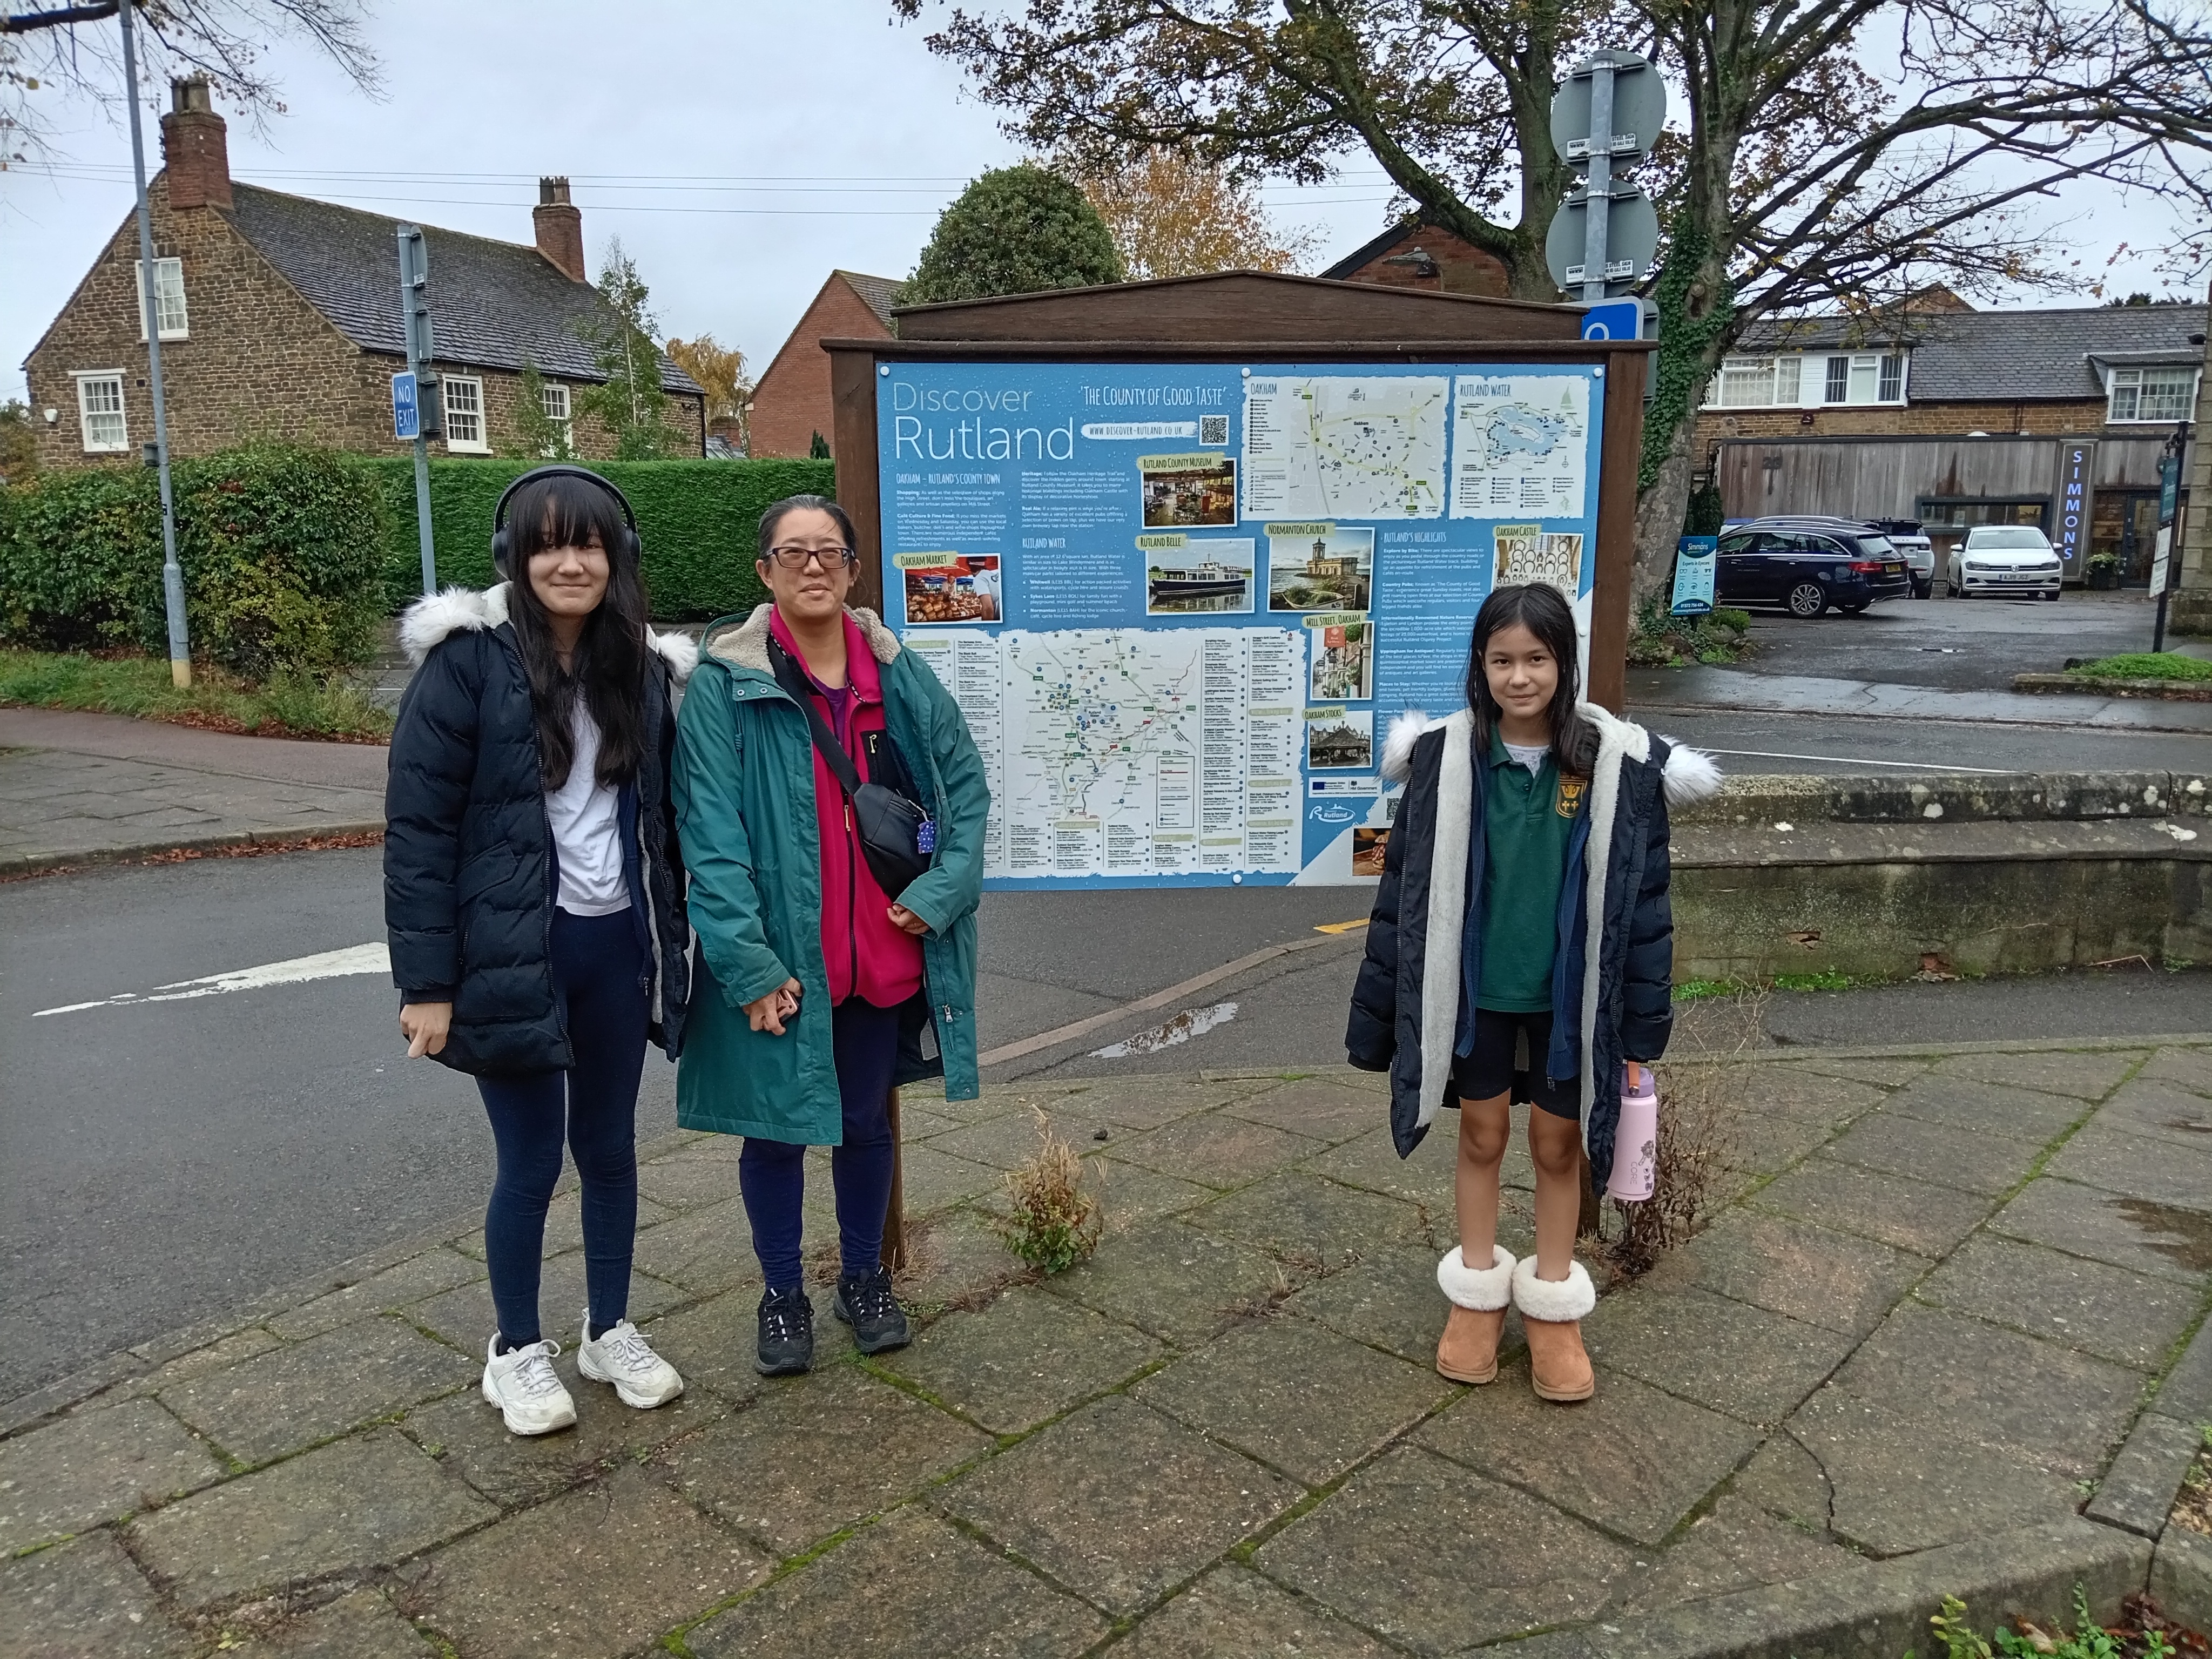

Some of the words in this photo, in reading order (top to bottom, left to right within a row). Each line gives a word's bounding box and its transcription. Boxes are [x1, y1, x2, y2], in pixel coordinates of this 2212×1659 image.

[398, 385, 411, 403] NO
[1251, 383, 1277, 395] OAKHAM
[1460, 384, 1489, 397] RUTLAND
[1491, 384, 1511, 397] WATER
[894, 382, 1033, 412] Discover
[1103, 385, 1145, 406] COUNTY
[1147, 386, 1161, 406] OF
[1163, 385, 1193, 406] GOOD
[398, 408, 414, 427] EXIT
[895, 416, 1074, 460] Rutland
[1144, 459, 1166, 469] RUTLAND
[1168, 458, 1188, 468] COUNTY
[1189, 457, 1212, 467] MUSEUM
[896, 473, 921, 484] OAKHAM
[960, 473, 982, 484] COUNTY
[983, 473, 1001, 484] TOWN
[2064, 450, 2083, 562] SIMMONS
[1269, 524, 1305, 535] NORMANTON
[1306, 524, 1326, 535] CHURCH
[1496, 527, 1519, 537] OAKHAM
[1519, 527, 1536, 536] CASTLE
[1022, 538, 1047, 549] RUTLAND
[1048, 538, 1066, 548] WATER
[1141, 537, 1165, 548] RUTLAND
[1166, 536, 1181, 547] BELLE
[1414, 532, 1447, 543] HIGHLIGHTS
[1688, 543, 1709, 551] Simmons
[901, 555, 925, 567] OAKHAM
[926, 554, 947, 565] MARKET
[1306, 617, 1318, 627] MILL
[1304, 711, 1324, 720] OAKHAM
[1323, 710, 1342, 719] STOCKS
[1630, 1161, 1638, 1185] CORE
